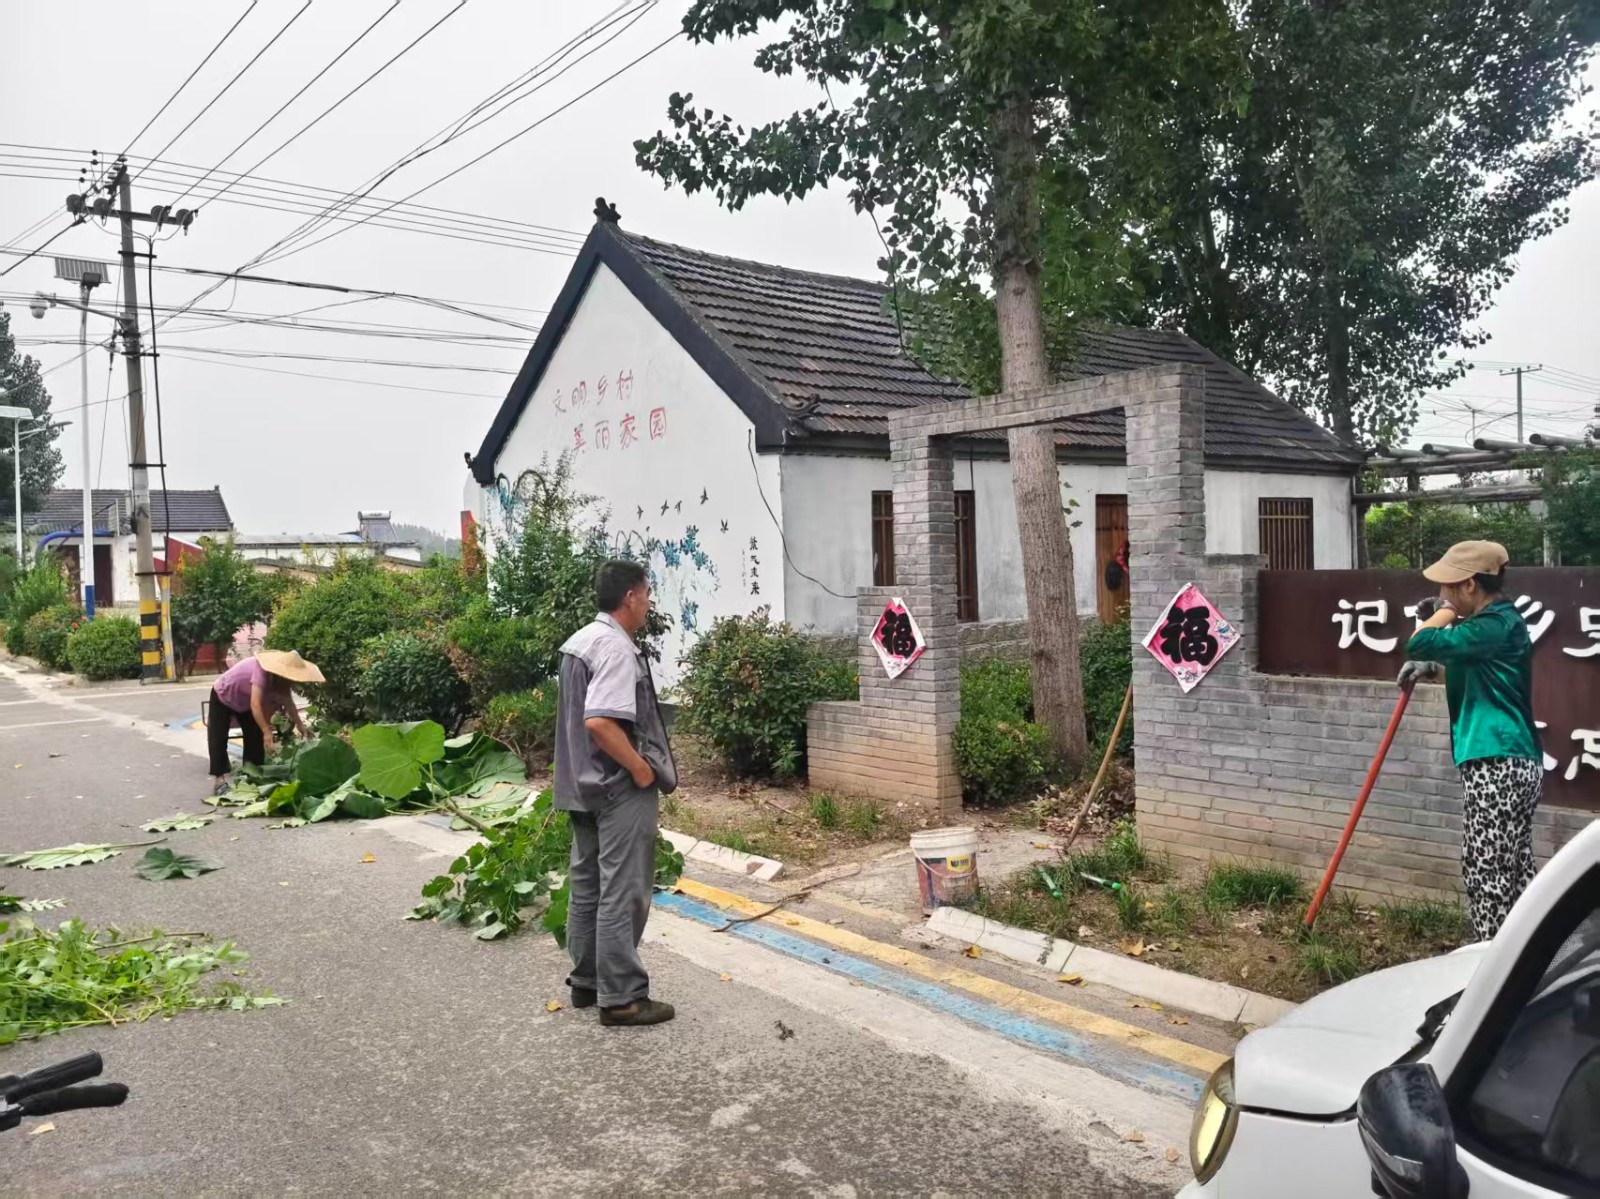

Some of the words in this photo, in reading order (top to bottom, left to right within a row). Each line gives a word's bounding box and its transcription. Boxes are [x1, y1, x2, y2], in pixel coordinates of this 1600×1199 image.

[552, 369, 634, 416] 文明乡村
[573, 407, 667, 454] 美丽家园
[881, 608, 918, 660] 福
[1160, 606, 1219, 666] 福
